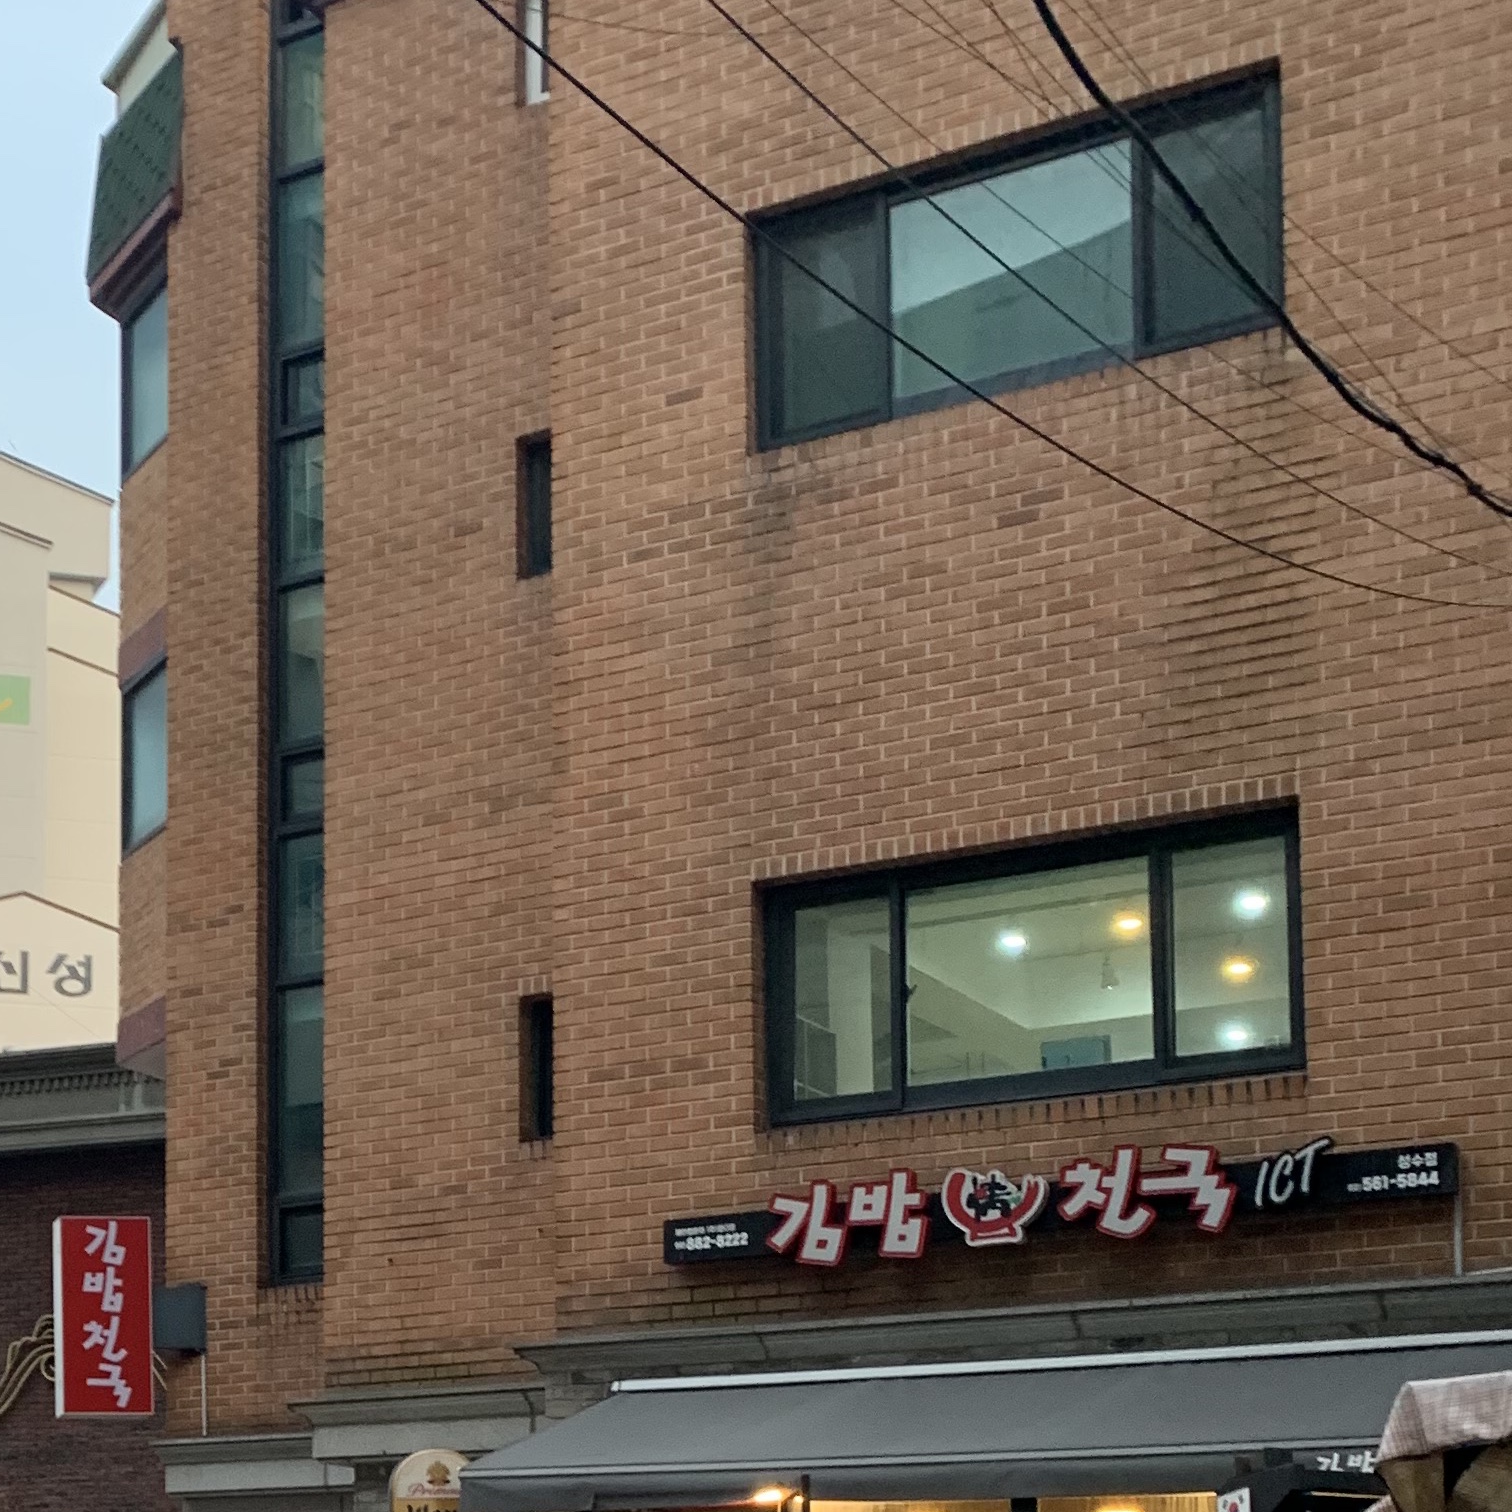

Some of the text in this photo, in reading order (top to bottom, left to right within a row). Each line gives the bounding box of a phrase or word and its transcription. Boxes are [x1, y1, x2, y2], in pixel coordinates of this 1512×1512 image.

[767, 1168, 929, 1266] 김밥
[1058, 1144, 1236, 1238] 천국
[1254, 1136, 1333, 1209] ICT
[82, 1220, 133, 1409] 김밥천국
